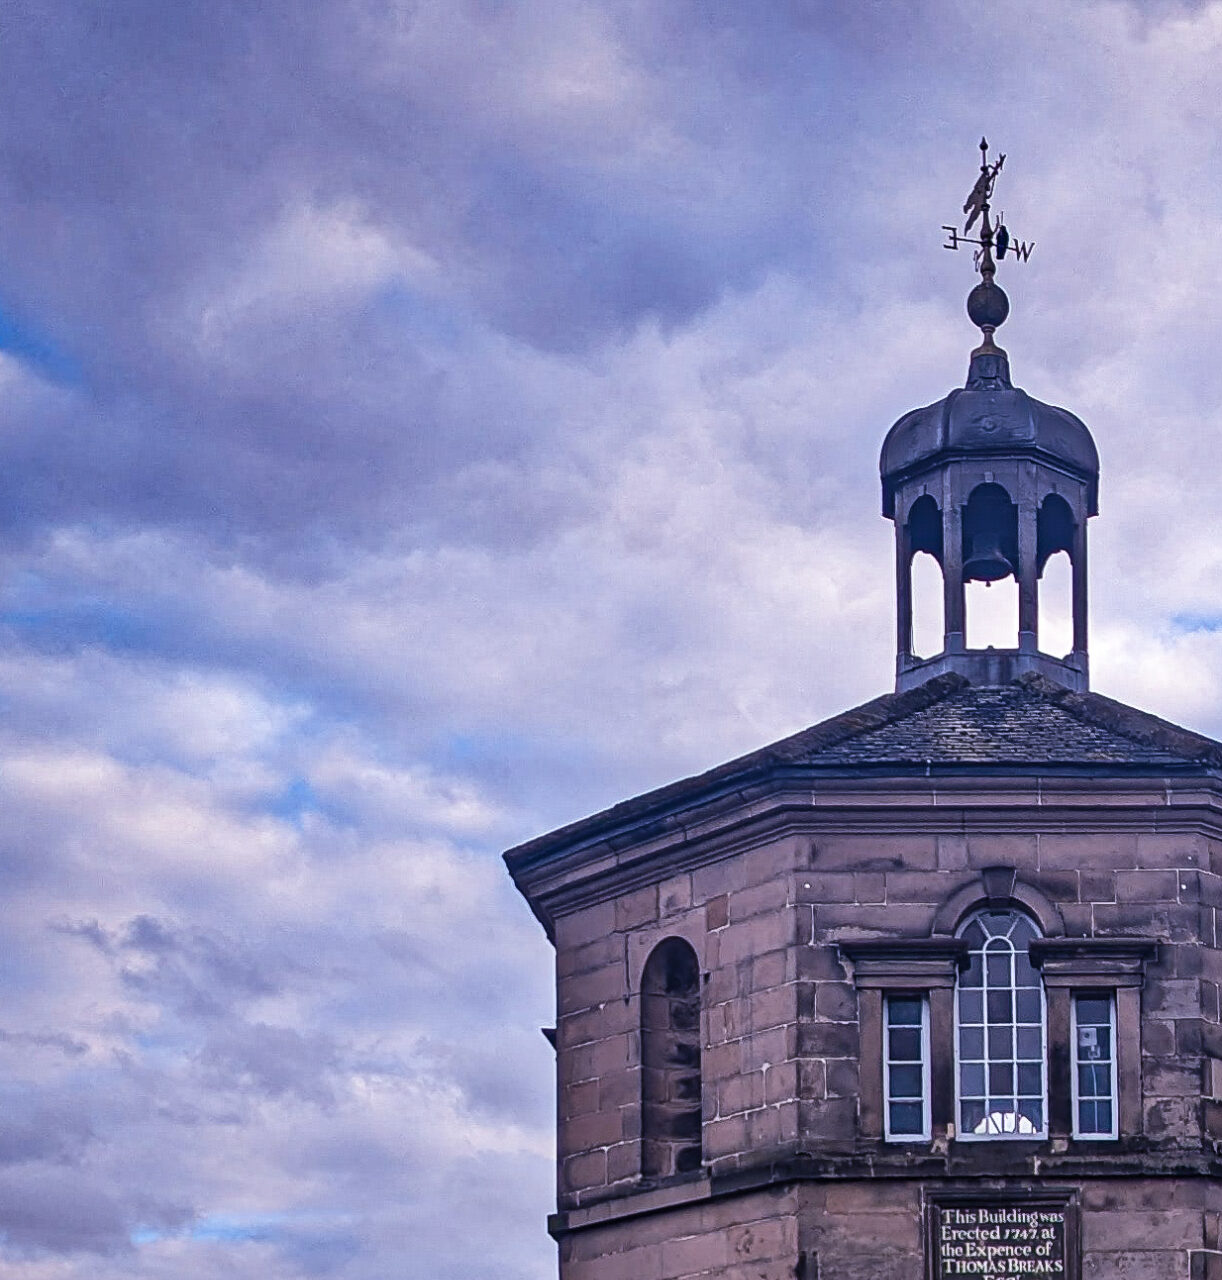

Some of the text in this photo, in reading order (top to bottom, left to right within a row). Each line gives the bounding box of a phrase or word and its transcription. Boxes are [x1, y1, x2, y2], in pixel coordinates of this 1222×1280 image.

[1013, 238, 1036, 262] W
[942, 1209, 1064, 1228] This Building was
[942, 1226, 1000, 1240] Erected
[1041, 1227, 1056, 1239] at
[941, 1242, 1053, 1260] the Expence of
[942, 1258, 1063, 1273] THOMAS BREAKS
